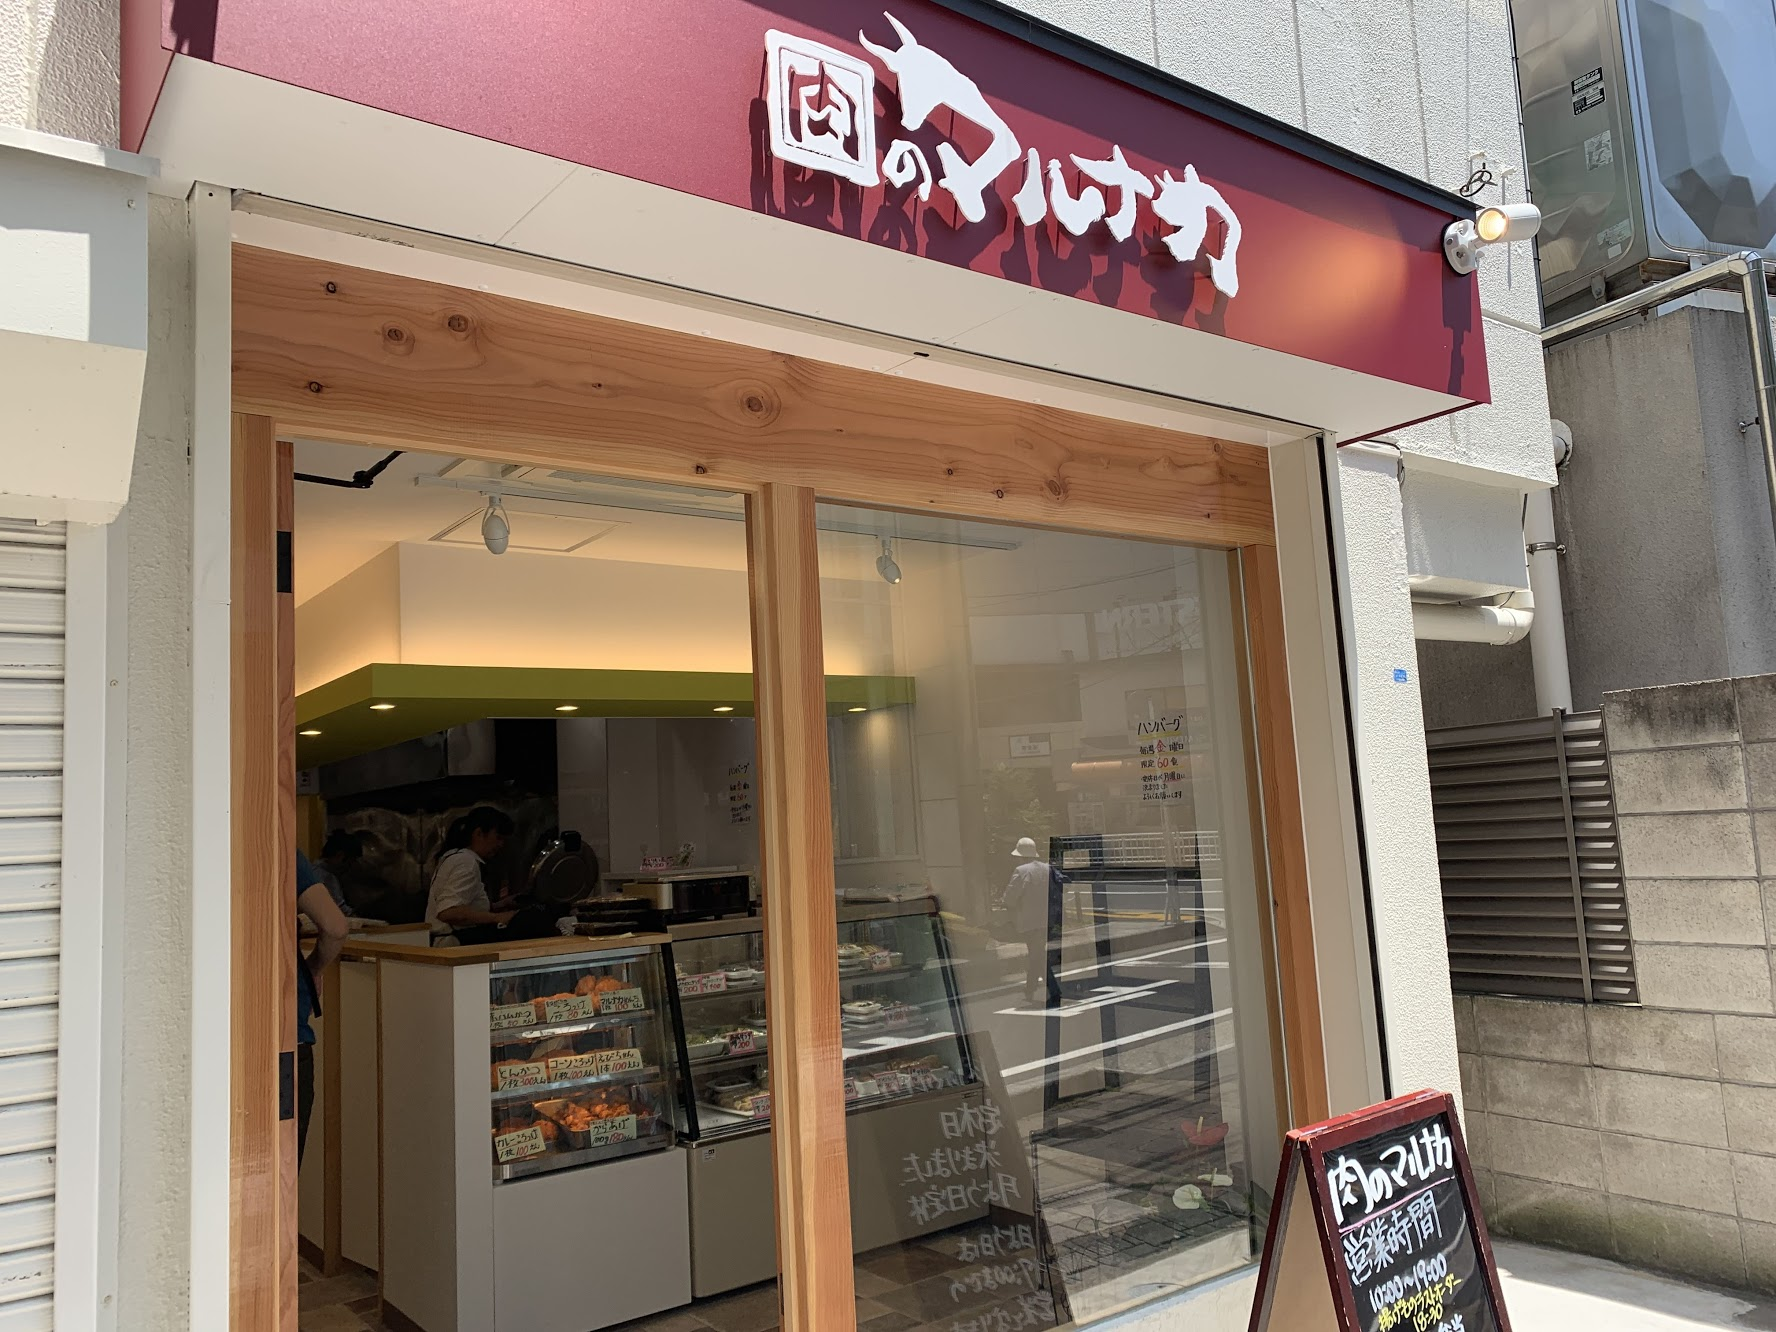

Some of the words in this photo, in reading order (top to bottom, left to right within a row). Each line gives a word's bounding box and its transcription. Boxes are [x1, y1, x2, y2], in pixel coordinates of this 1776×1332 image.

[1137, 714, 1184, 735] ハンバーグ
[1327, 1122, 1453, 1225] 肉のマルナカ
[1343, 1189, 1443, 1286] 営業時間
